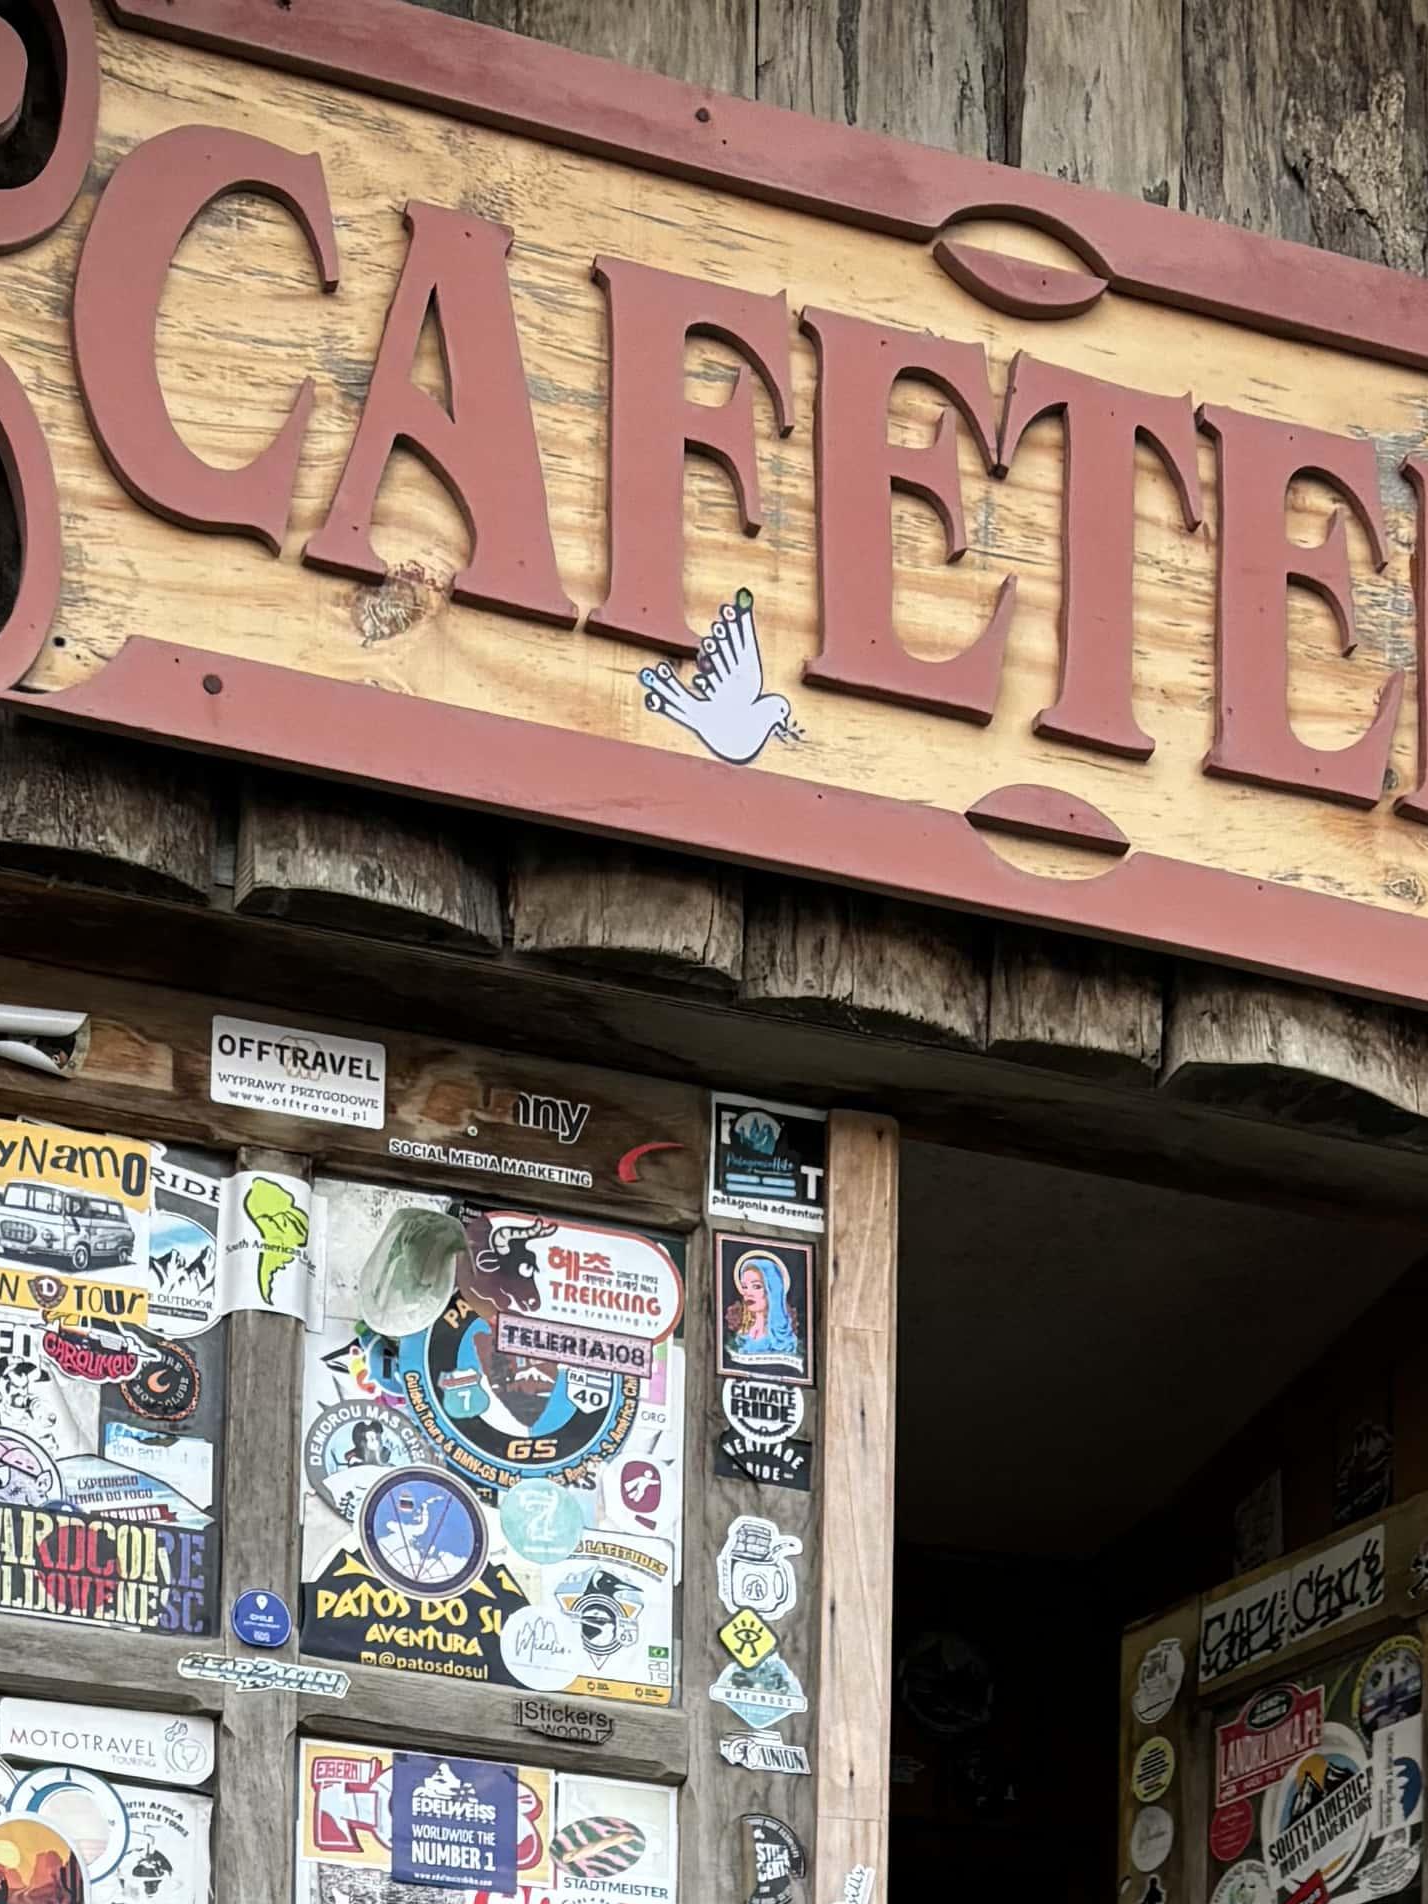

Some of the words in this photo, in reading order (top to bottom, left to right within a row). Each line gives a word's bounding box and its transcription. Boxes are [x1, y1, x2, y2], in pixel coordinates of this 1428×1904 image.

[217, 1034, 380, 1083] OFFTRAVEL
[217, 1072, 286, 1095] WYPRAWY
[289, 1081, 380, 1110] PRZYGODOWE
[389, 1139, 446, 1164] SOCIAL
[450, 1147, 498, 1171] MEDIA
[500, 1154, 593, 1186] MARKETING
[548, 1246, 614, 1281] 혜초
[159, 1293, 213, 1309] OUTDOOR
[549, 1281, 661, 1316] TREKKING
[574, 1390, 604, 1408] 40
[731, 1384, 795, 1406] CLIMATE
[730, 1400, 795, 1424] RIDE
[308, 1411, 362, 1468] DEMOROU
[365, 1405, 401, 1424] MAS
[506, 1440, 558, 1459] GS
[584, 1539, 667, 1577] LATITUDES
[316, 1586, 412, 1621] PATOS
[419, 1599, 468, 1626] DO
[365, 1624, 484, 1658] AVENTURA
[378, 1651, 489, 1681] @patosdosul
[523, 1701, 609, 1728] Stickers
[10, 1728, 157, 1757] MOTOTRAVEL
[761, 1748, 804, 1770] UNION
[411, 1797, 496, 1820] EDELWEISS
[411, 1824, 473, 1845] WORLDWIDE
[475, 1829, 497, 1847] THE
[1269, 1827, 1312, 1867] SOUTH
[410, 1842, 482, 1871] NUMBER
[484, 1852, 495, 1872] 1
[563, 1876, 669, 1899] STADTMEISTER
